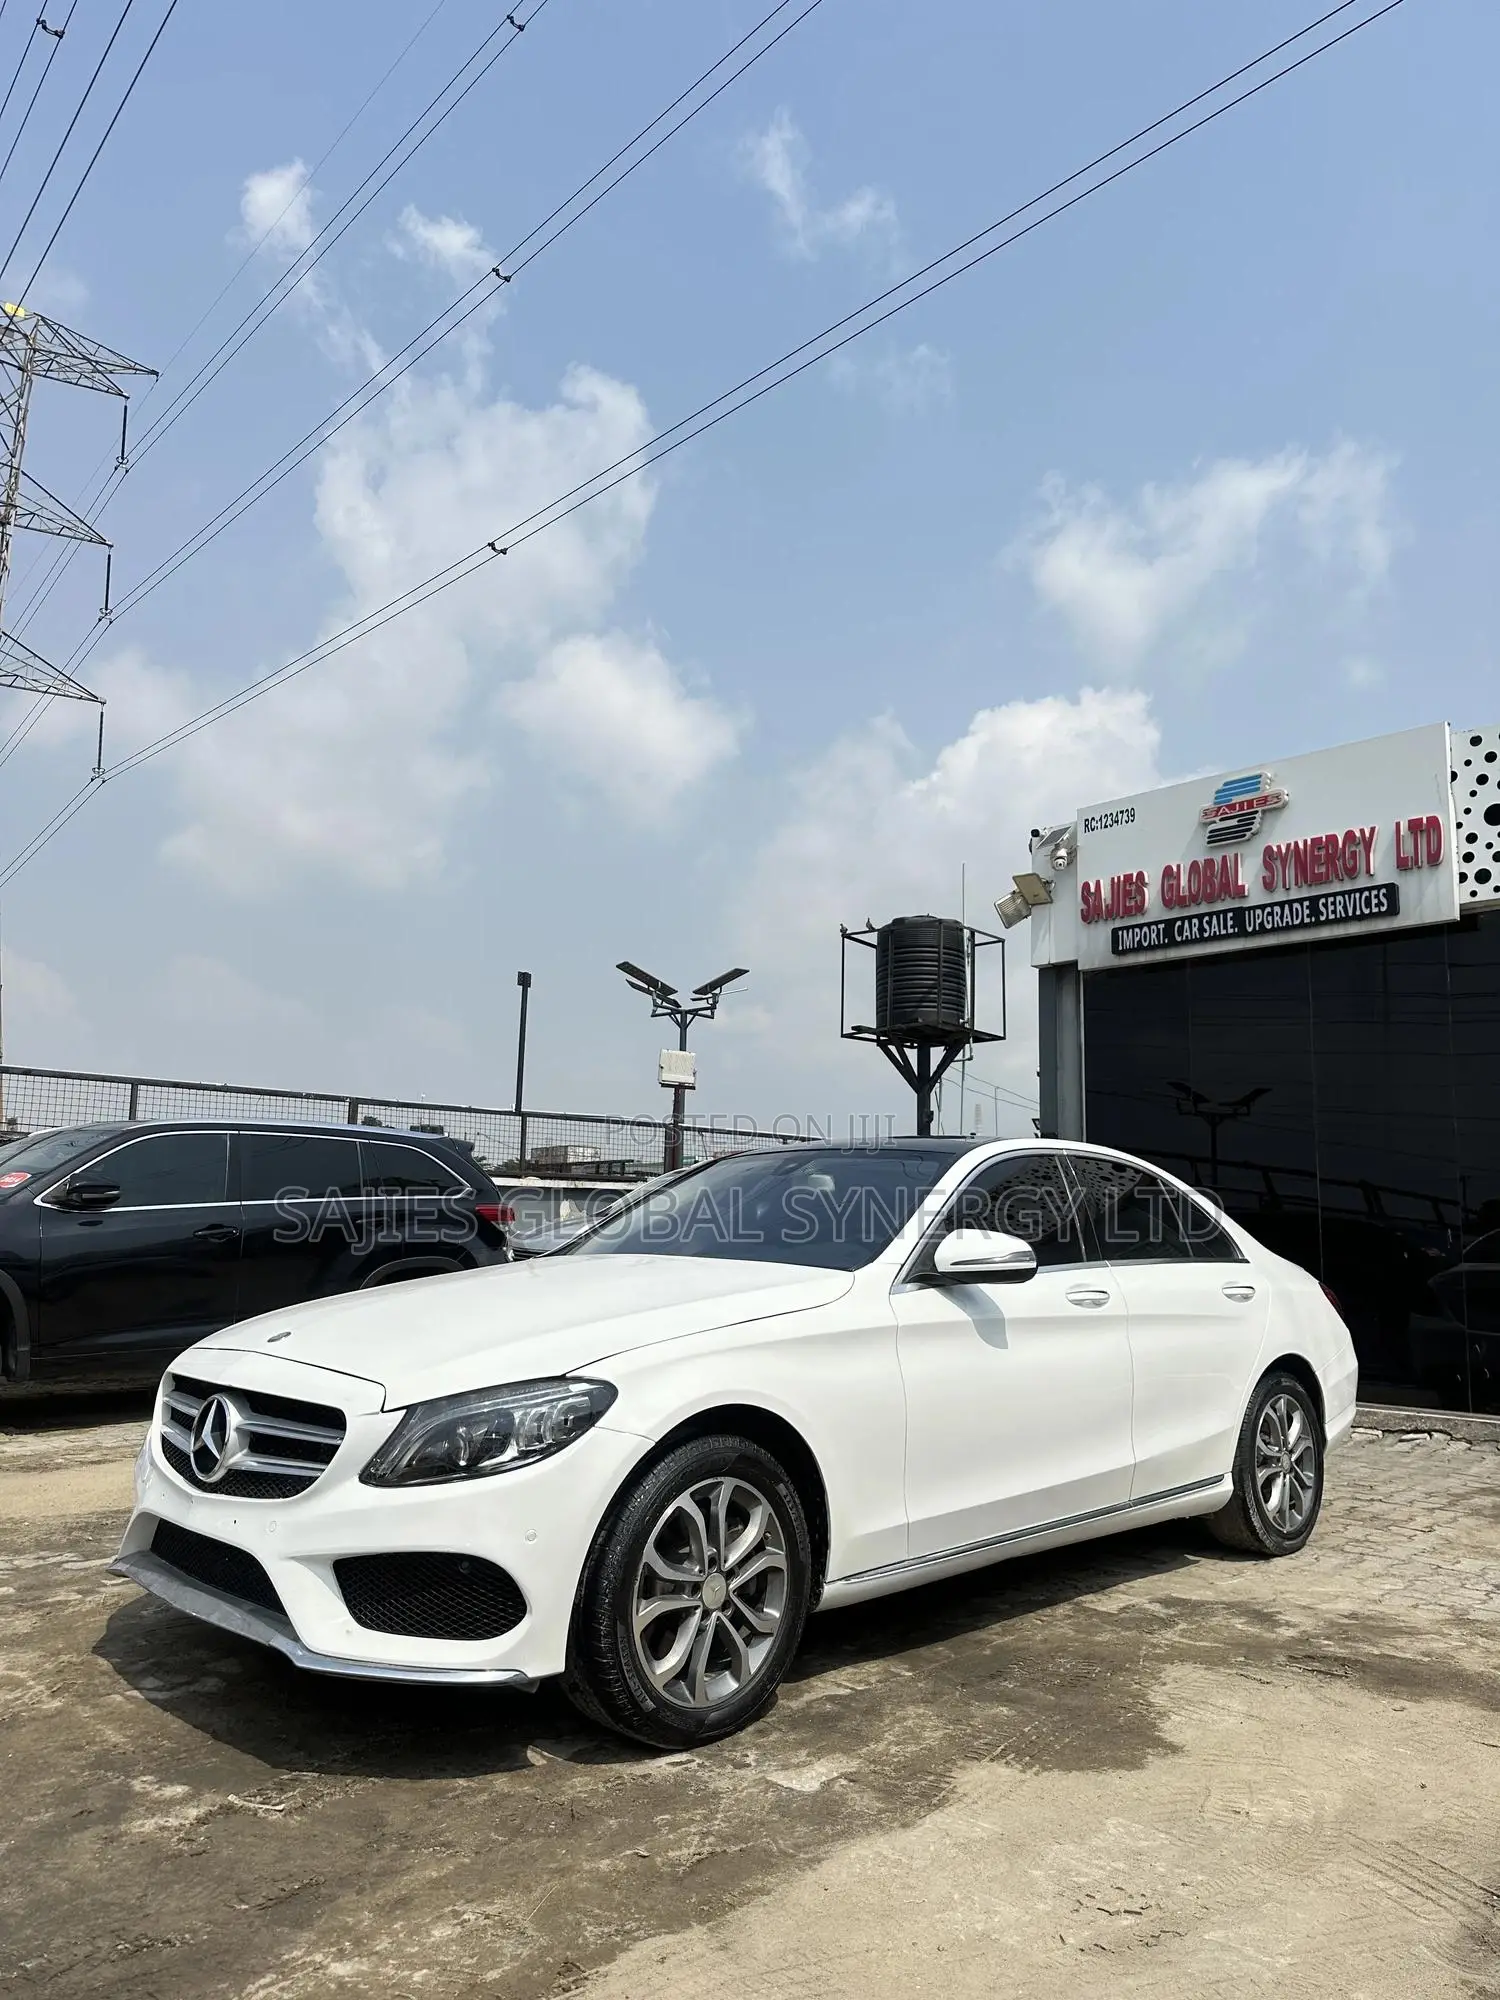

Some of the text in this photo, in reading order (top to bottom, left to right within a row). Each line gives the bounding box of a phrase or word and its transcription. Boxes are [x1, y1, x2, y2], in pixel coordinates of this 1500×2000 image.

[1084, 807, 1136, 833] RC:1234739
[1201, 792, 1281, 820] SAJIES
[1080, 814, 1444, 924] SAJIES GLOBAL SYNERGY LTD
[1118, 888, 1388, 951] IMPORT. CAR SALE. UPGRADE. SERVICES
